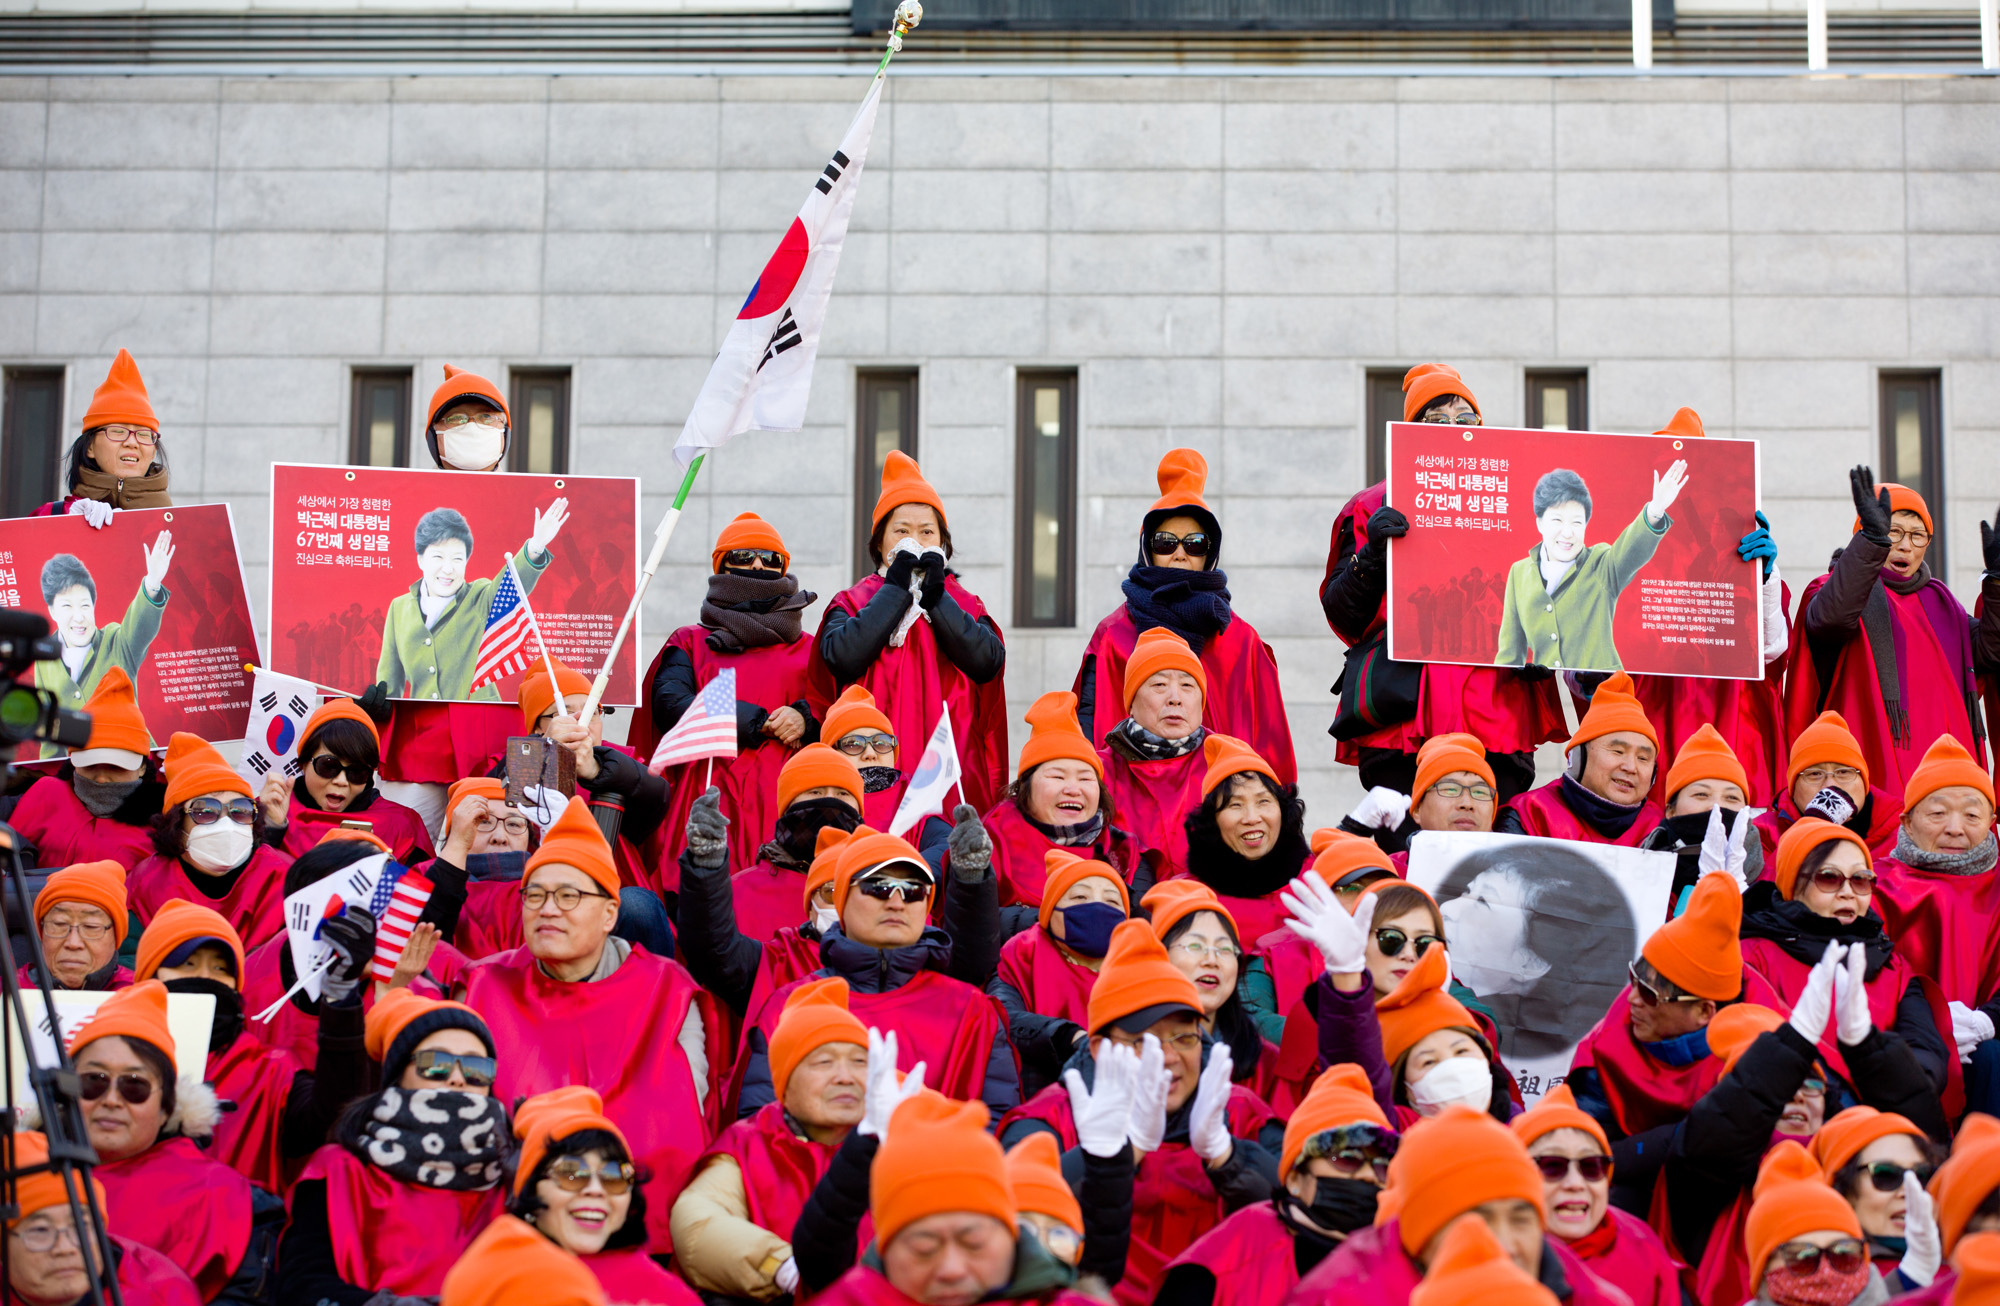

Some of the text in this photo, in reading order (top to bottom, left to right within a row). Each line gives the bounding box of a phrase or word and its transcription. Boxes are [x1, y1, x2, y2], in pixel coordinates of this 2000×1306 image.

[1415, 455, 1509, 472] 세상에서 가장 청렴한
[1416, 471, 1508, 493] 박근혜 대통령님
[297, 495, 391, 511] 세상에서 가장 청렴한
[1415, 492, 1509, 514] 67번째 생일을
[297, 511, 390, 531] 박근혜 대통령님
[1415, 515, 1512, 532] 진심으로 축하드립니다.
[296, 531, 390, 551] 67번째 생일을
[296, 553, 393, 568] 진심으로 축하드립니다.
